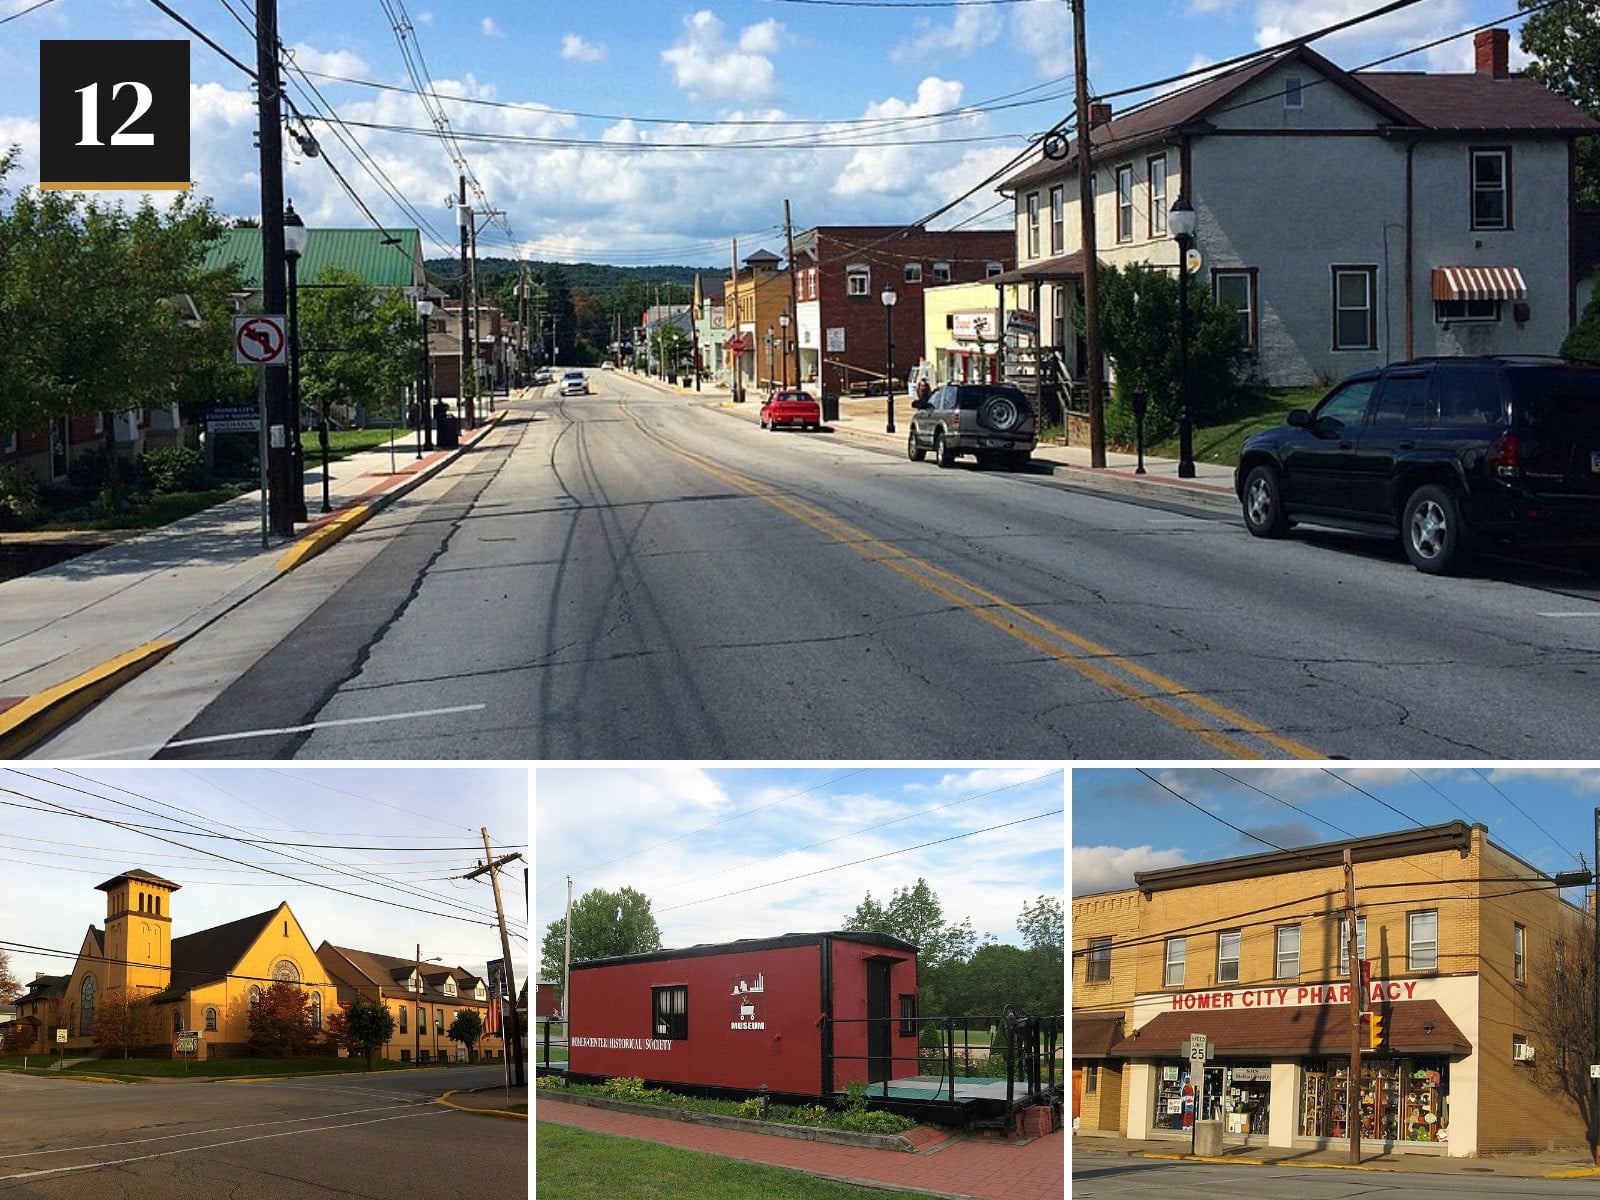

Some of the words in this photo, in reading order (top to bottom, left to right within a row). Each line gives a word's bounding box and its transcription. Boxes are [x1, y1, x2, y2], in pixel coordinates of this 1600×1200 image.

[1172, 992, 1233, 1010] HOMER
[1242, 987, 1288, 1007] CITY
[1297, 981, 1417, 1005] PHARACY
[730, 1021, 765, 1030] MUSEUM
[609, 1038, 643, 1050] HISTORICAL
[645, 1038, 672, 1050] SOCIETY
[1191, 1048, 1204, 1060] 25
